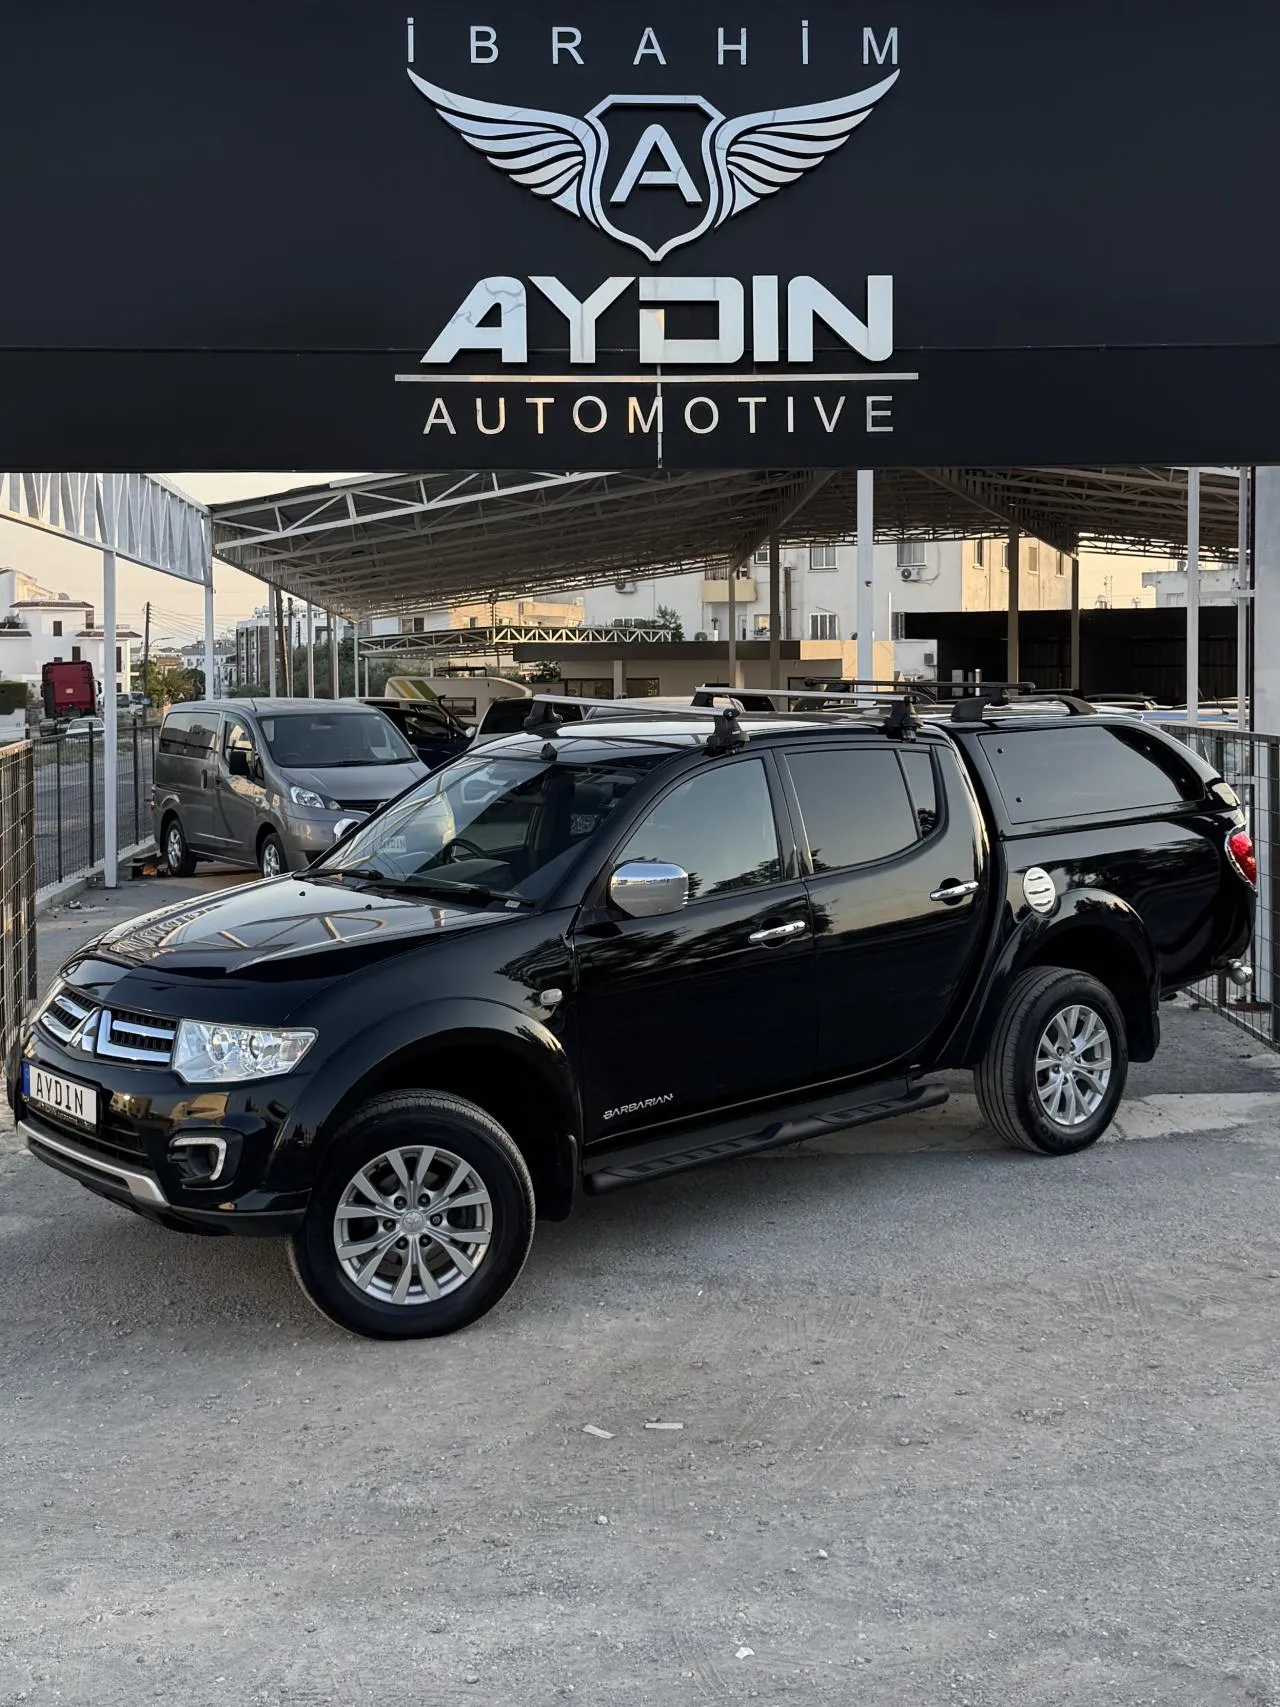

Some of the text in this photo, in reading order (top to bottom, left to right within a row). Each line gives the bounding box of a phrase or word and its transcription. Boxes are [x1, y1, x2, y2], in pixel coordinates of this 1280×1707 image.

[406, 17, 900, 65] İBRAHİM
[609, 123, 704, 203] A
[419, 274, 894, 364] AYDIN
[422, 395, 895, 435] AUTOMOTIVE
[36, 1072, 84, 1116] AYDIN
[602, 1092, 674, 1120] BARBARIAN
